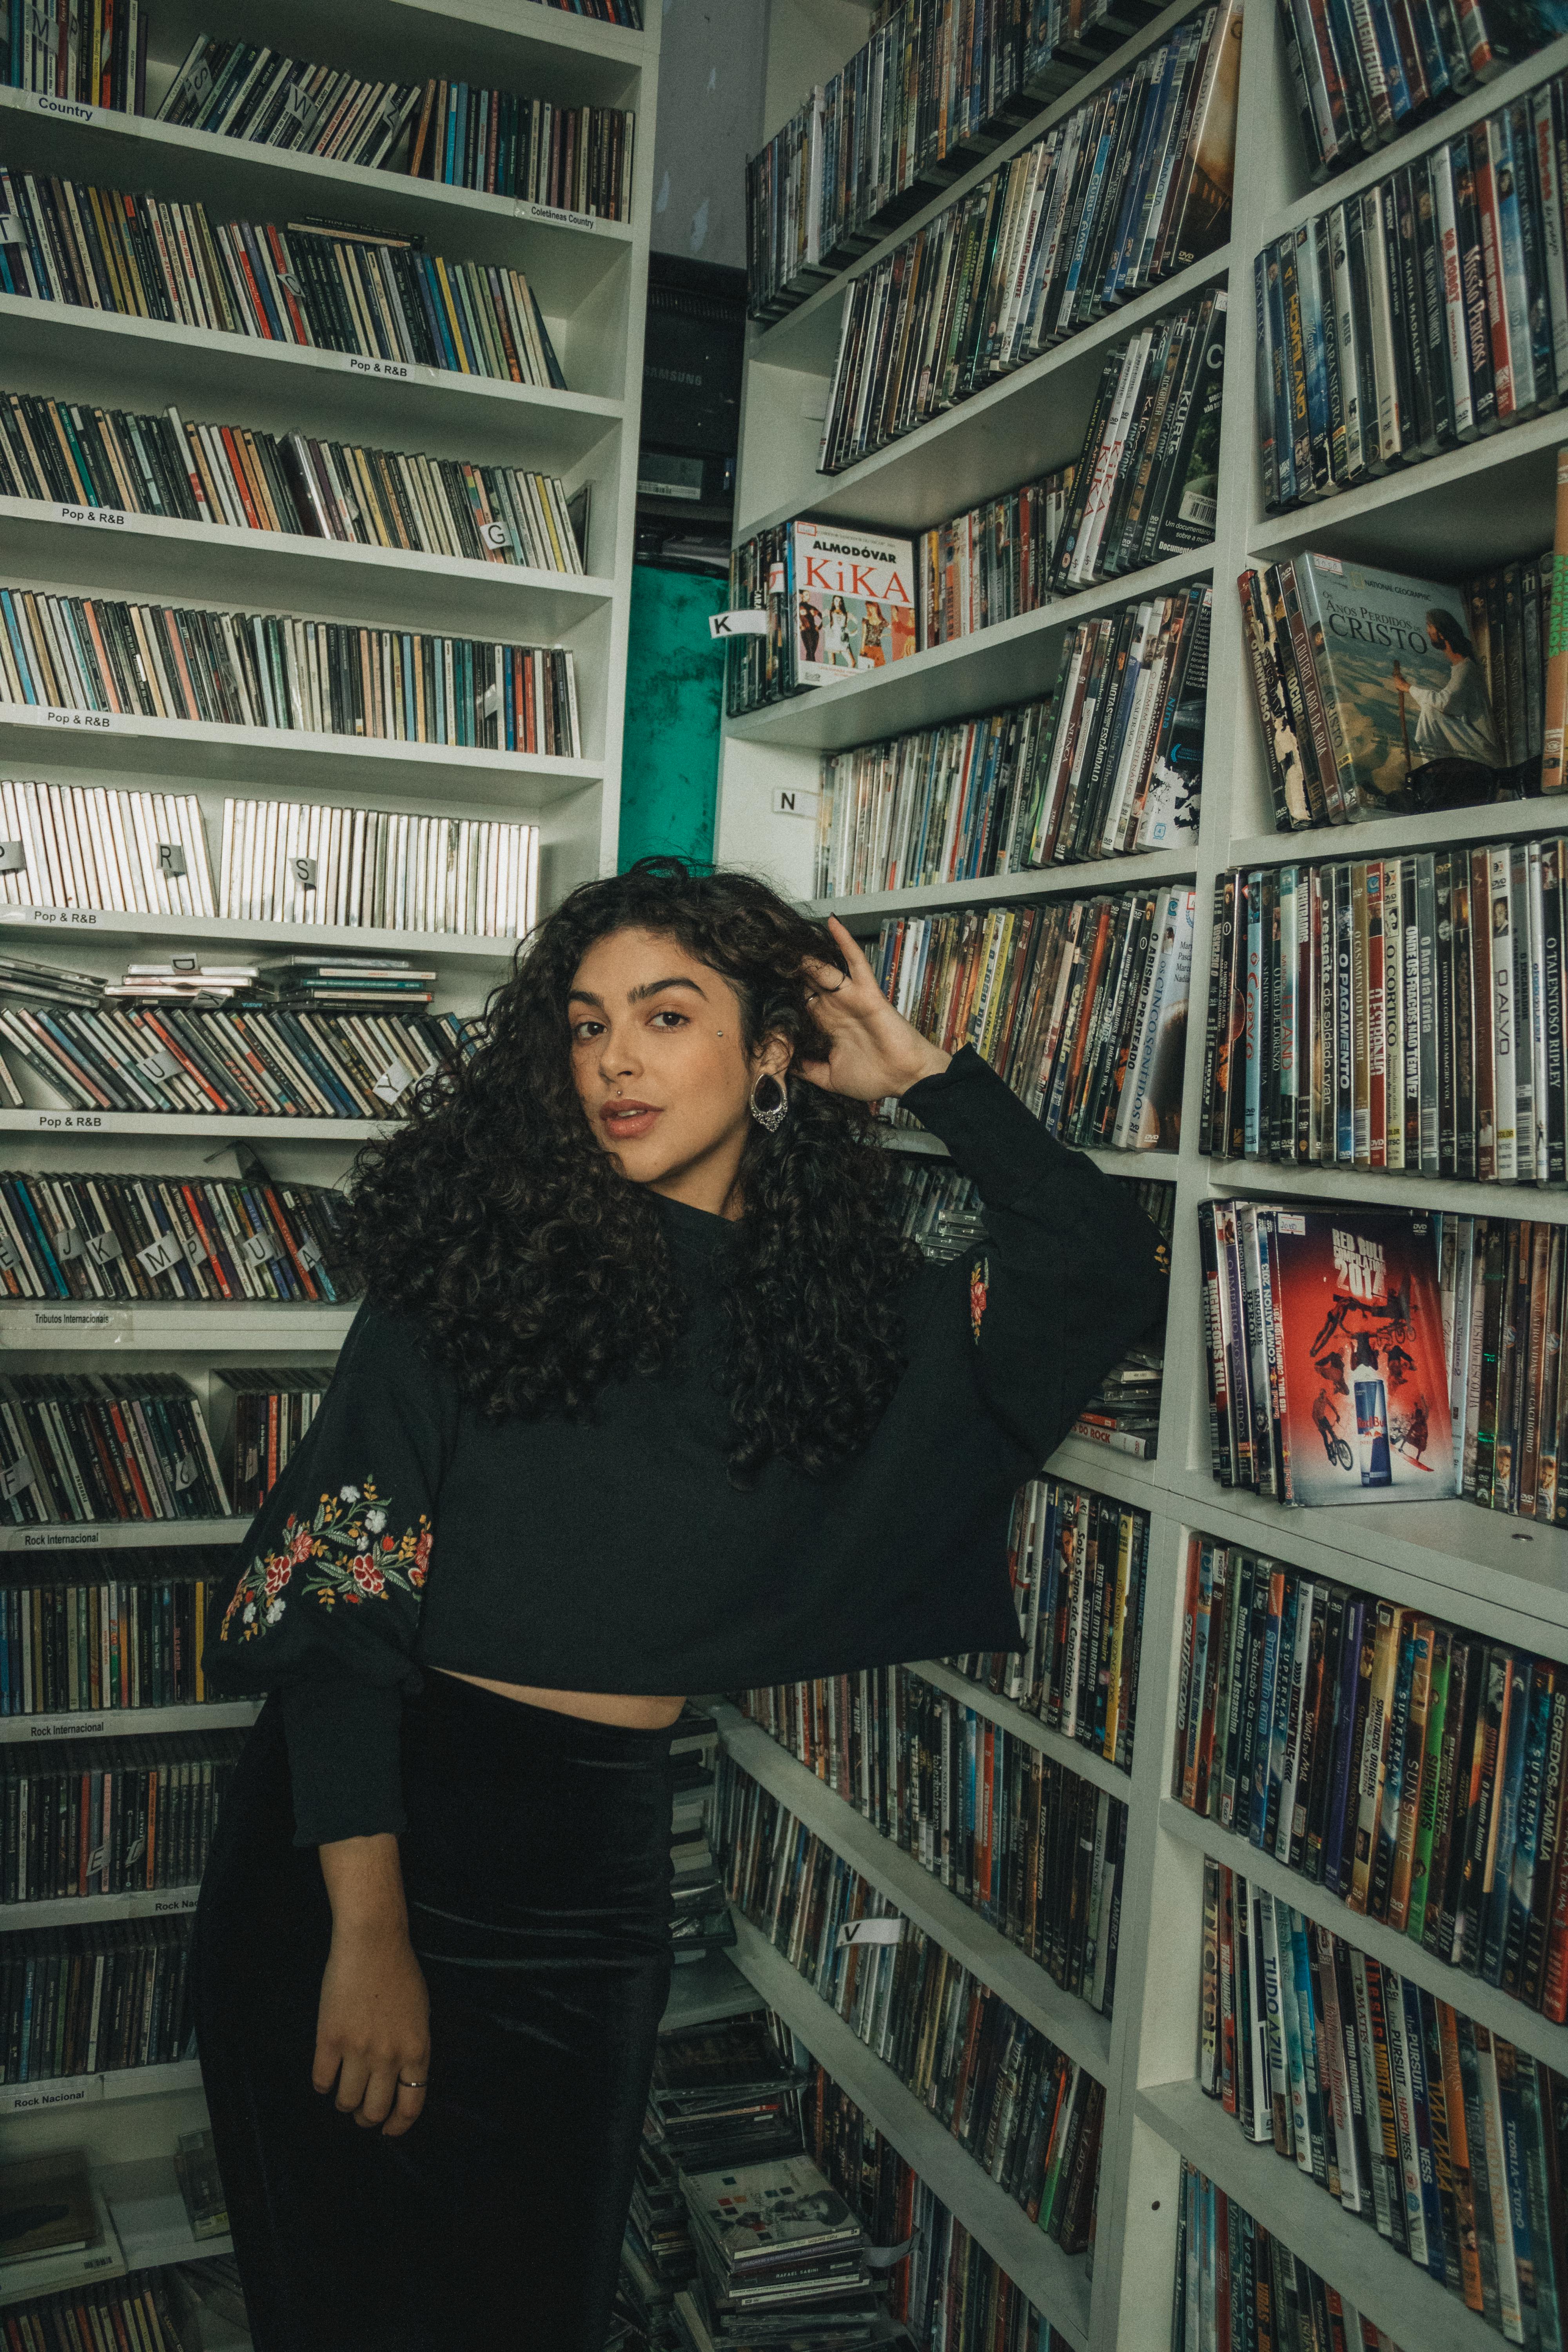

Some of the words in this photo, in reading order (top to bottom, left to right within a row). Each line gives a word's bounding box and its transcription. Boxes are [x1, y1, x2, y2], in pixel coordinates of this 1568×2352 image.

[39, 97, 93, 121] Country
[532, 207, 566, 221] Coletâneas
[568, 215, 593, 229] Country
[350, 359, 370, 372] Pop
[374, 363, 381, 372] &
[385, 365, 407, 377] R&B
[62, 508, 84, 521] Pop
[87, 512, 96, 521] &
[99, 513, 125, 525] R&B
[488, 525, 506, 544] G
[813, 540, 896, 564] ALMODÓVAR
[1364, 580, 1394, 593] NATIONAL
[1394, 586, 1432, 601] GEOGRAPHIC
[1326, 600, 1357, 618] ANOS
[1360, 607, 1412, 628] PERDIDOS
[713, 616, 731, 635] K
[1328, 613, 1428, 655] CRISTO
[48, 712, 70, 724] Pop
[85, 716, 110, 728] R&B
[1163, 697, 1175, 729] Nina
[781, 791, 795, 811] N
[160, 845, 172, 868] R
[296, 859, 309, 880] S
[34, 911, 56, 923] Pop
[60, 913, 68, 922] &
[72, 914, 97, 924] R&B
[1141, 944, 1156, 998] ABISMO
[1338, 953, 1349, 968] O
[1497, 969, 1509, 986] O
[1546, 951, 1559, 1034] TALENTOSO
[1339, 973, 1350, 1089] PAGAMENTO
[1497, 992, 1510, 1055] ALVO
[1128, 1002, 1146, 1070] PRATEADO
[1547, 1037, 1561, 1089] RIPLEY
[40, 1117, 61, 1129] Pop
[65, 1118, 74, 1126] &
[76, 1117, 102, 1127] R&B
[1413, 1223, 1427, 1231] DVD
[1332, 1228, 1356, 1255] RED
[35, 1314, 62, 1323] Tributos
[64, 1314, 109, 1324] Internacionais
[1263, 1289, 1276, 1365] COMPILATION
[1090, 1427, 1111, 1444] ROCK
[25, 1535, 46, 1545] Rock
[47, 1532, 99, 1545] Internacional
[31, 1726, 52, 1737] Rock
[53, 1722, 104, 1735] Internacional
[155, 1901, 178, 1911] Rock
[843, 1921, 859, 1942] V
[15, 2098, 40, 2107] Rock
[42, 2091, 84, 2103] Nacional
